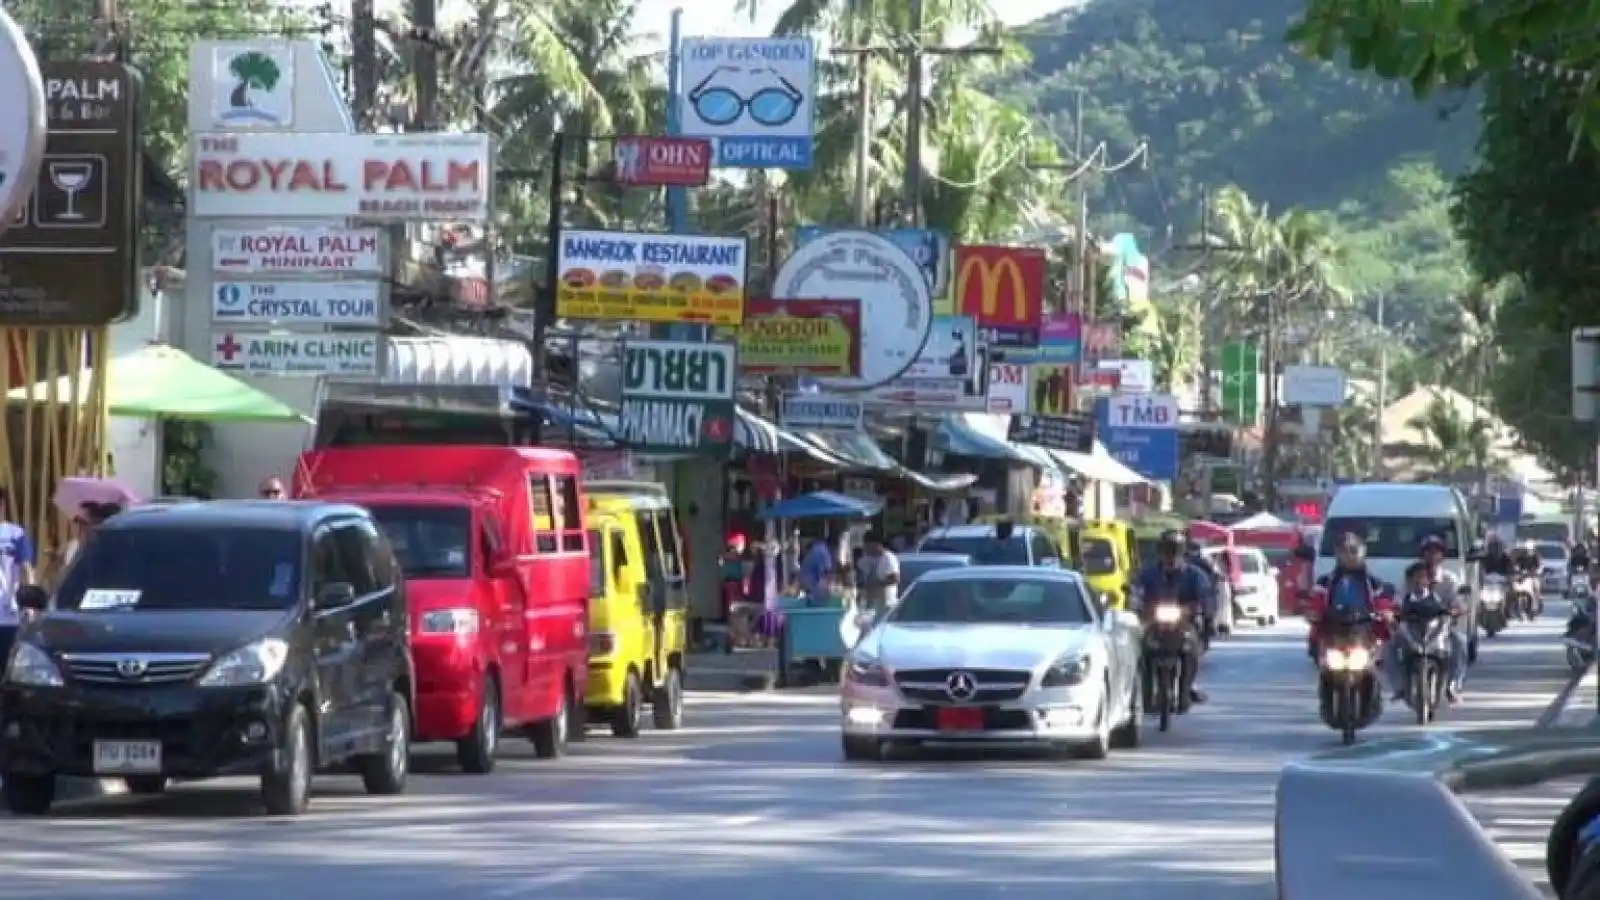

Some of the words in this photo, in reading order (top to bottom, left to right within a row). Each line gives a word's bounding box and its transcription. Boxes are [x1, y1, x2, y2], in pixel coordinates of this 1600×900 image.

[46, 79, 120, 101] PALM
[201, 138, 238, 152] THE
[724, 142, 801, 162] OPTICAL
[199, 159, 347, 192] ROYAL
[363, 159, 479, 192] PALM
[241, 236, 311, 252] ROYAL
[318, 236, 375, 253] PALM
[564, 238, 637, 262] BANGKOK
[641, 242, 740, 266] RESTAURANT
[262, 256, 355, 267] MINIMART
[251, 285, 275, 295] THE
[248, 300, 322, 317] CRYSTAL
[328, 300, 374, 316] TOUR
[249, 340, 299, 357] ARIN
[622, 400, 703, 448] PHARMACY
[1117, 405, 1168, 425] TMB
